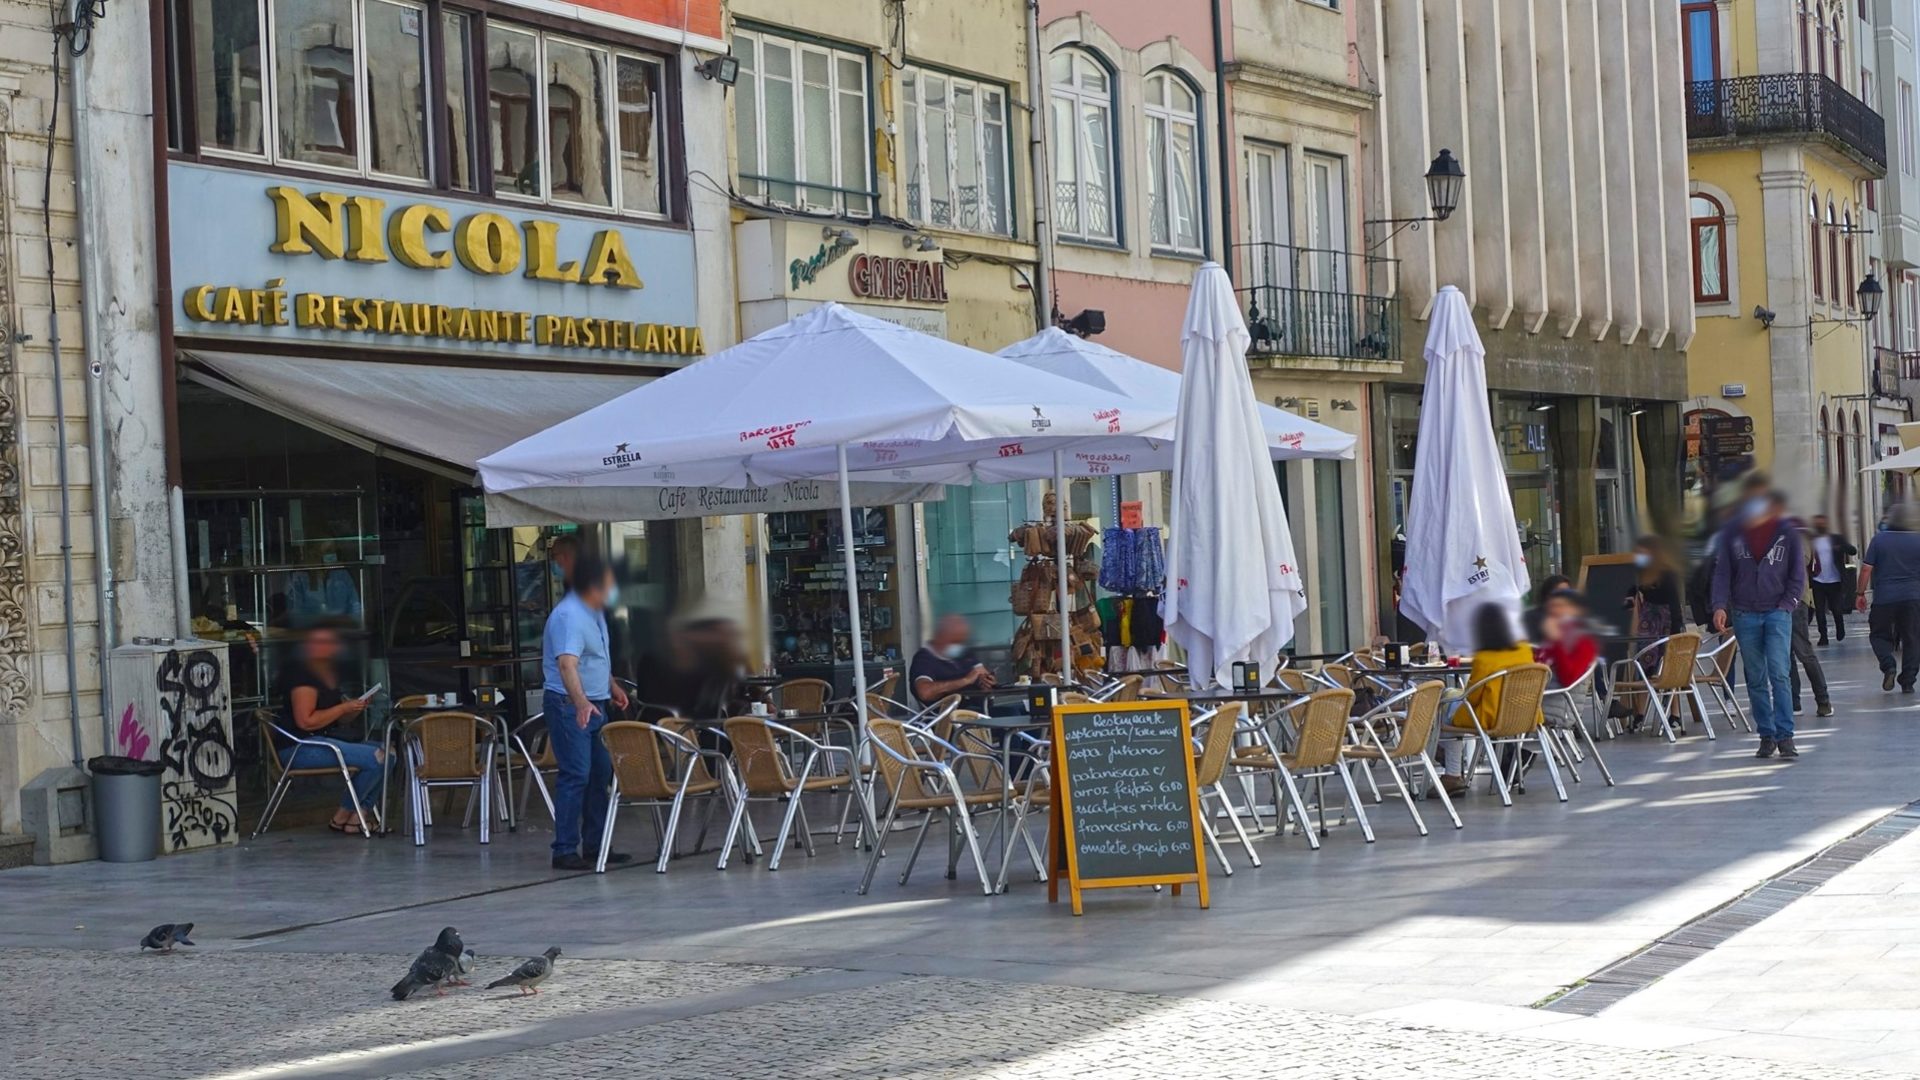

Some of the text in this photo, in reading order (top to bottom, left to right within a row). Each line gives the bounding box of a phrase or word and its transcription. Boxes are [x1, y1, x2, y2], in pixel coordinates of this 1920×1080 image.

[266, 186, 644, 289] NICOLA
[848, 253, 948, 302] CRISTAL
[183, 277, 706, 355] CAFÉ RESTAURANTE PASTELARIA
[767, 435, 795, 450] 1876
[998, 445, 1024, 457] 1876
[602, 452, 642, 466] ESTRELLA
[659, 480, 819, 514] Café Restaurante Nicola
[1069, 745, 1165, 763] sopa juliana
[1072, 767, 1150, 786] pataniscas
[1074, 786, 1109, 798] arroz
[1078, 819, 1162, 839] francesinha
